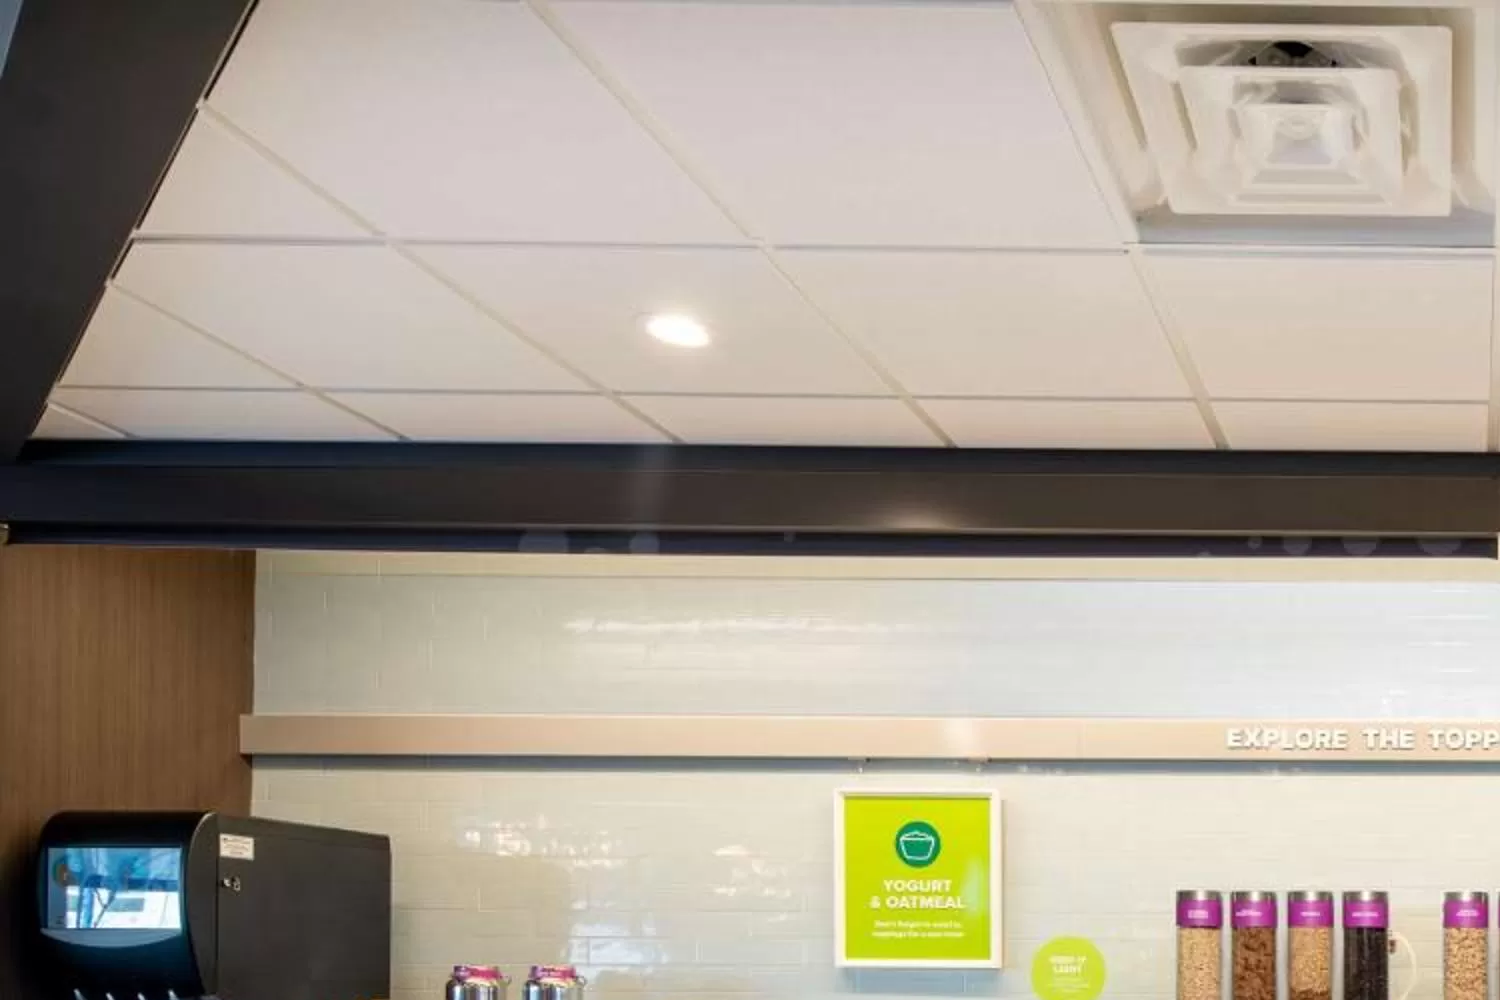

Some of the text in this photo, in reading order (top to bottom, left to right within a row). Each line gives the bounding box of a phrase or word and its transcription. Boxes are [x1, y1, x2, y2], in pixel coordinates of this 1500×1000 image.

[1226, 727, 1349, 750] EXPLORE
[1362, 728, 1415, 750] THE
[883, 879, 952, 892] YOGURT
[870, 896, 967, 909] & OATMEAL
